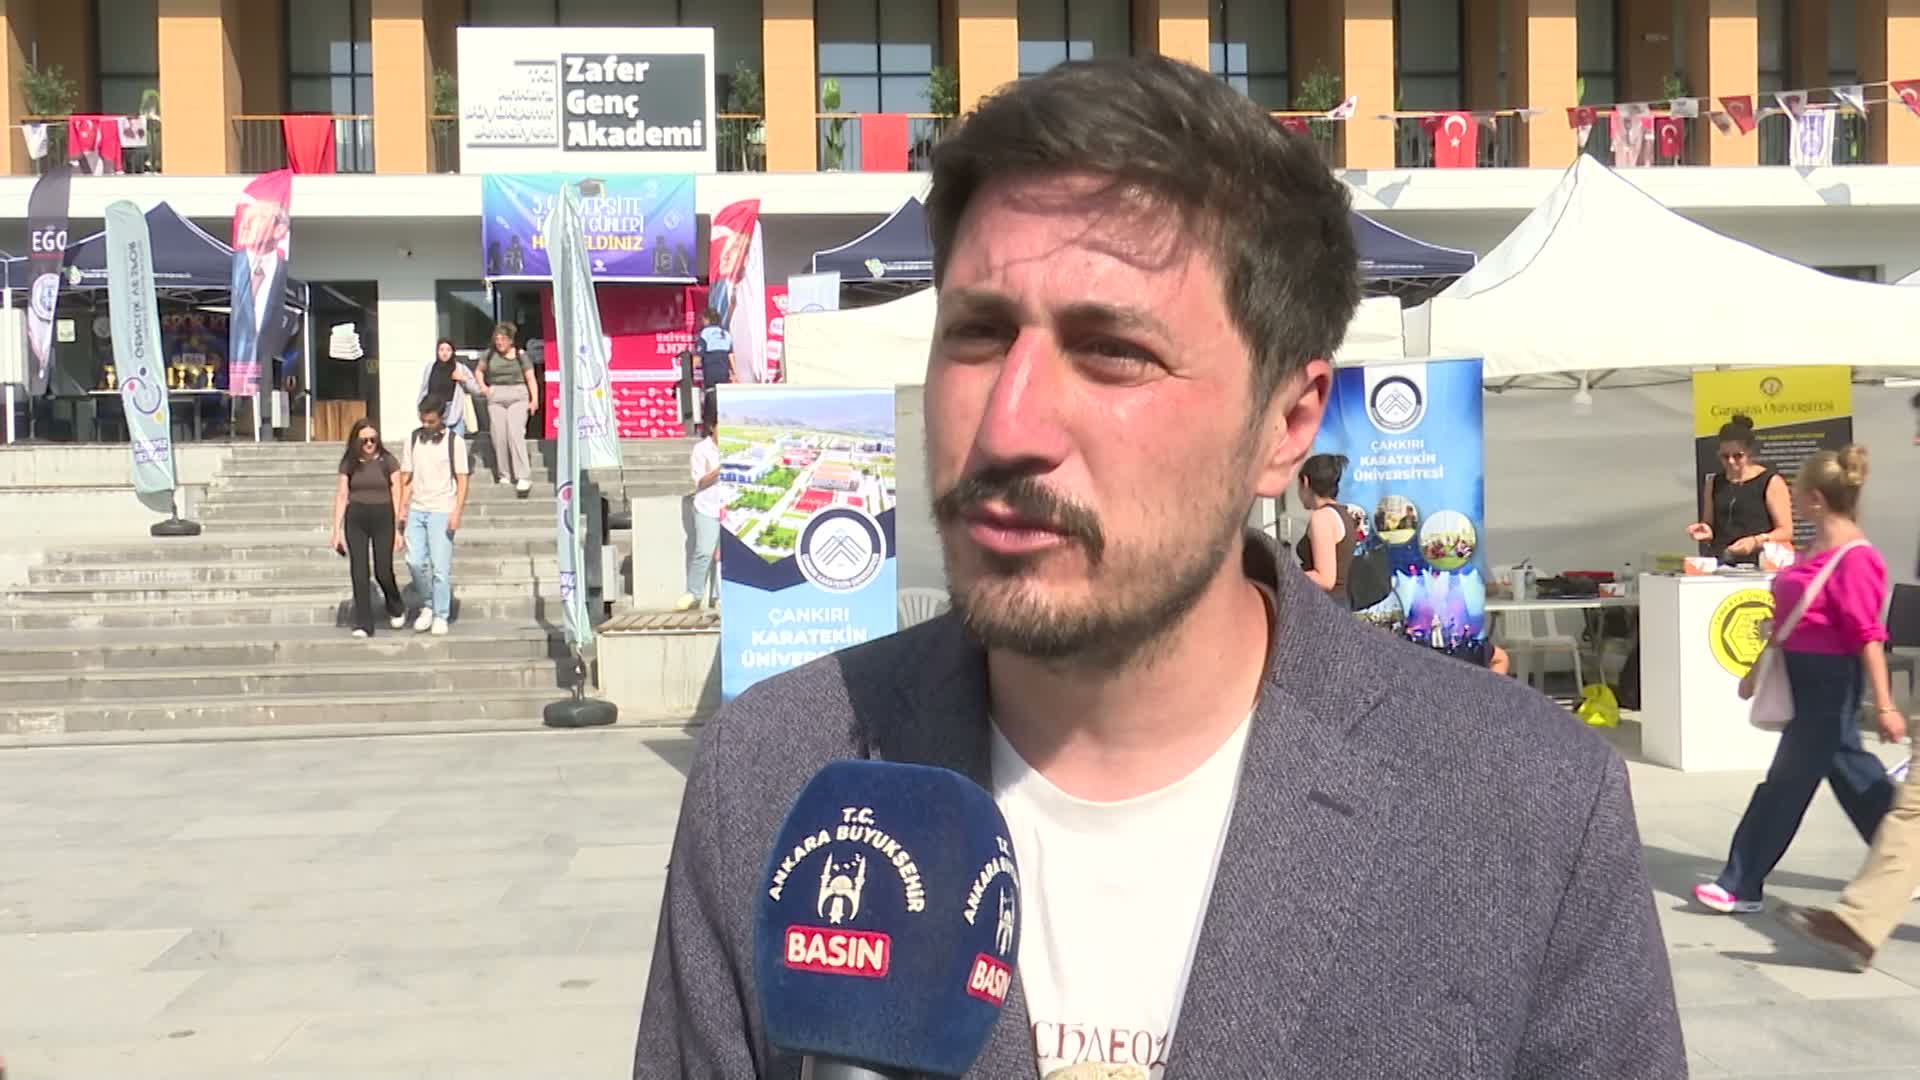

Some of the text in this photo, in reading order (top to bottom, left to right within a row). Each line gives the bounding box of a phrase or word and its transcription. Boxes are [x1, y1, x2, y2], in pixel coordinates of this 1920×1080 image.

[566, 55, 650, 82] Zafer
[566, 88, 640, 119] Genç
[567, 119, 702, 147] Akademi
[32, 230, 68, 252] EGO
[1371, 439, 1424, 453] ÇANKIRI
[768, 607, 850, 626] ÇANKIRI
[751, 624, 868, 646] KARATEKİN
[842, 807, 875, 825] T.C.
[769, 829, 831, 902] ANKARA
[787, 931, 884, 971] BASIN
